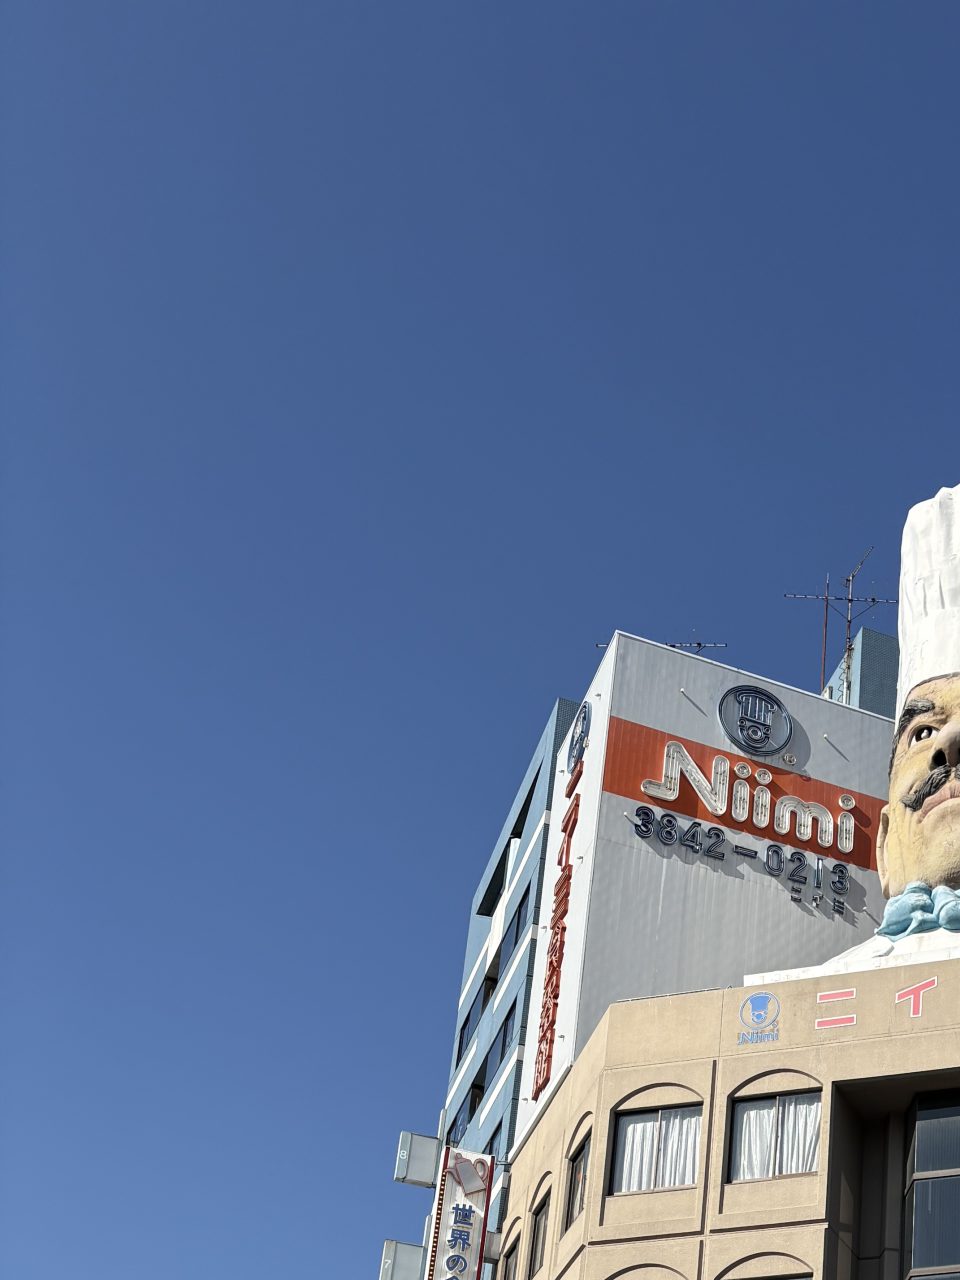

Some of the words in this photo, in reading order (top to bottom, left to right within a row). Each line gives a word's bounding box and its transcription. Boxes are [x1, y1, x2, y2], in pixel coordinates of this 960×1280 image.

[641, 741, 856, 853] Niimi
[634, 806, 851, 895] 3842-0213
[737, 1028, 779, 1046] Niimi
